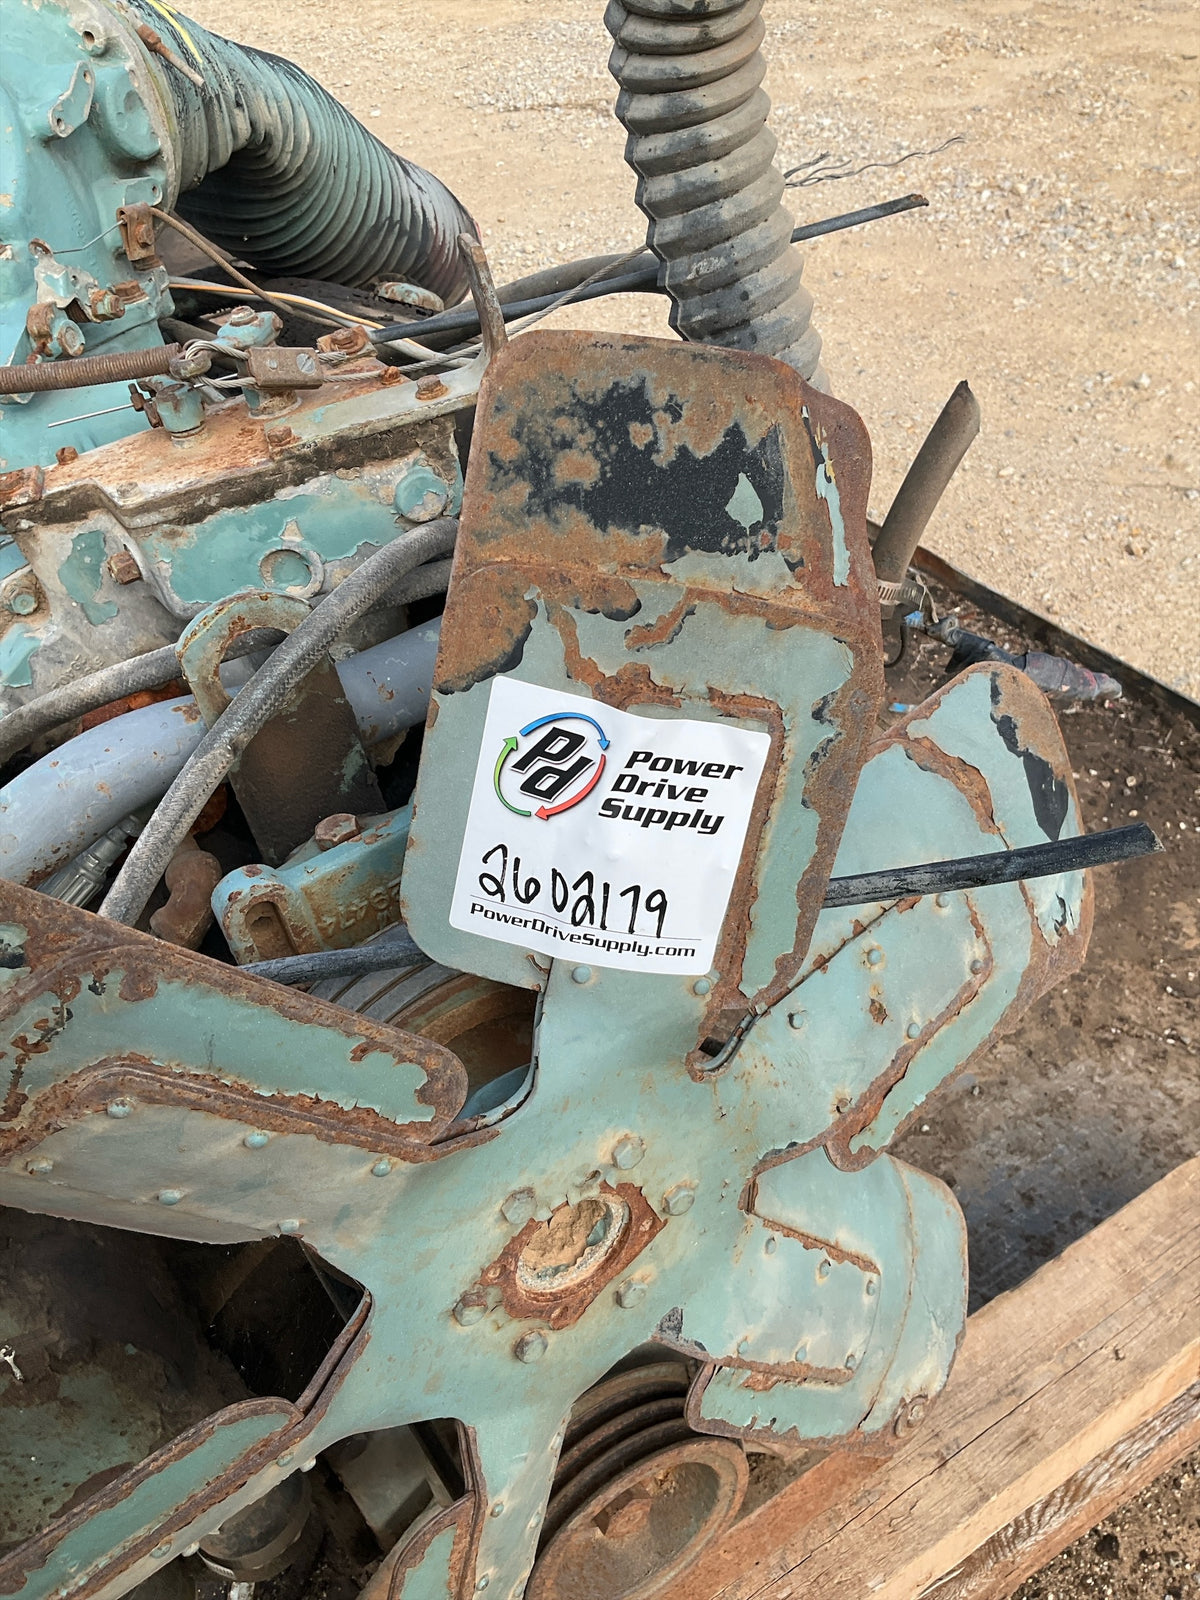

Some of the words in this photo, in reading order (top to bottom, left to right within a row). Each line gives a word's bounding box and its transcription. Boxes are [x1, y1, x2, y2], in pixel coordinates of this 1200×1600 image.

[625, 751, 743, 780] Power
[611, 774, 708, 803] Drive
[598, 798, 724, 834] Supply
[469, 902, 696, 957] PowerDriveSupply.com
